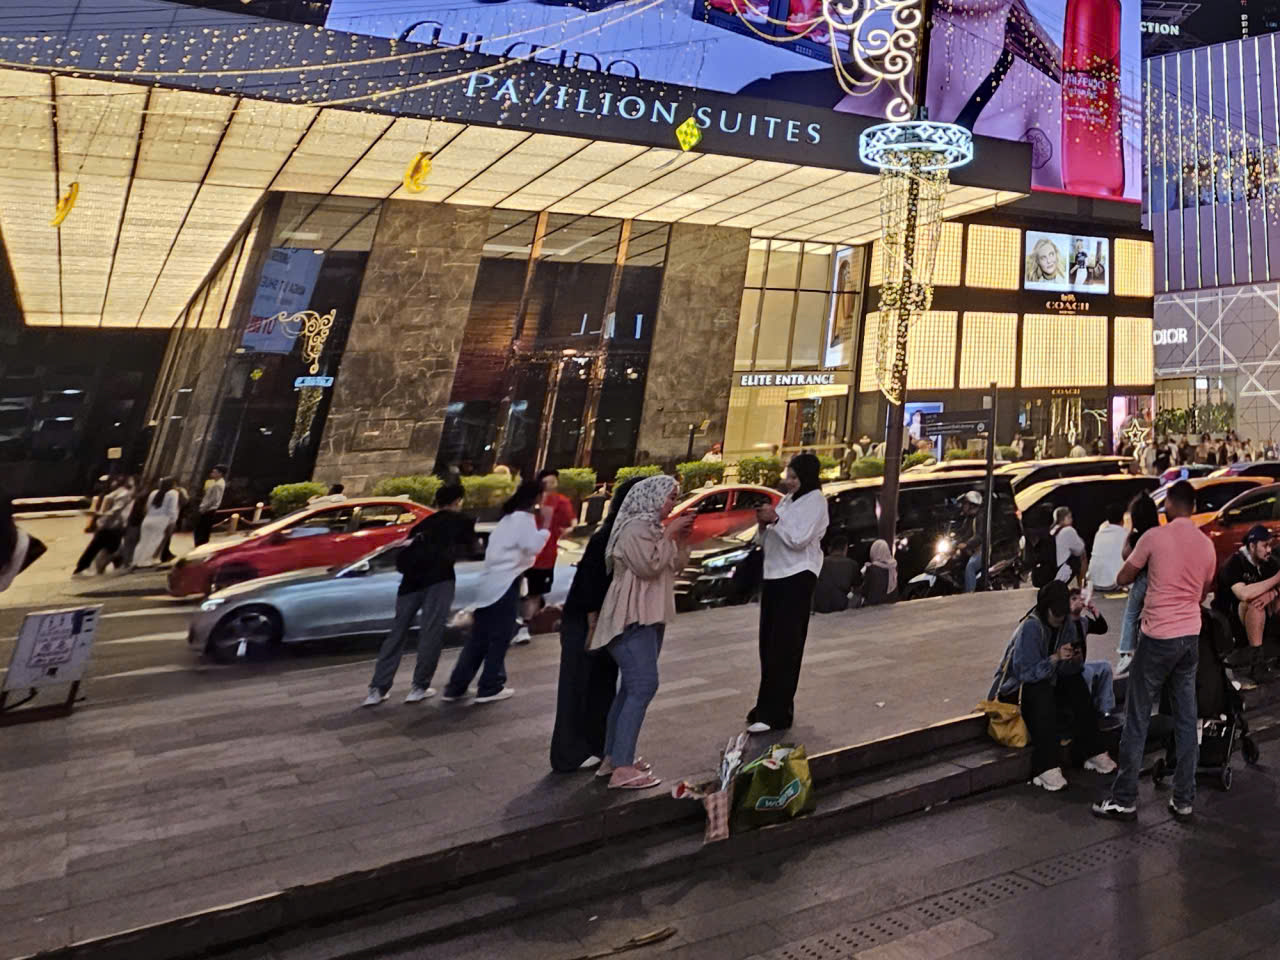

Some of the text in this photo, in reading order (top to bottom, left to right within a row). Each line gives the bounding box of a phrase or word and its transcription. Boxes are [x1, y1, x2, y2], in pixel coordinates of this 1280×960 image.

[695, 107, 821, 144] SUITES
[1046, 301, 1090, 310] COACH
[1153, 328, 1188, 345] DIOR
[741, 374, 835, 386] ELITE ENTRANCE
